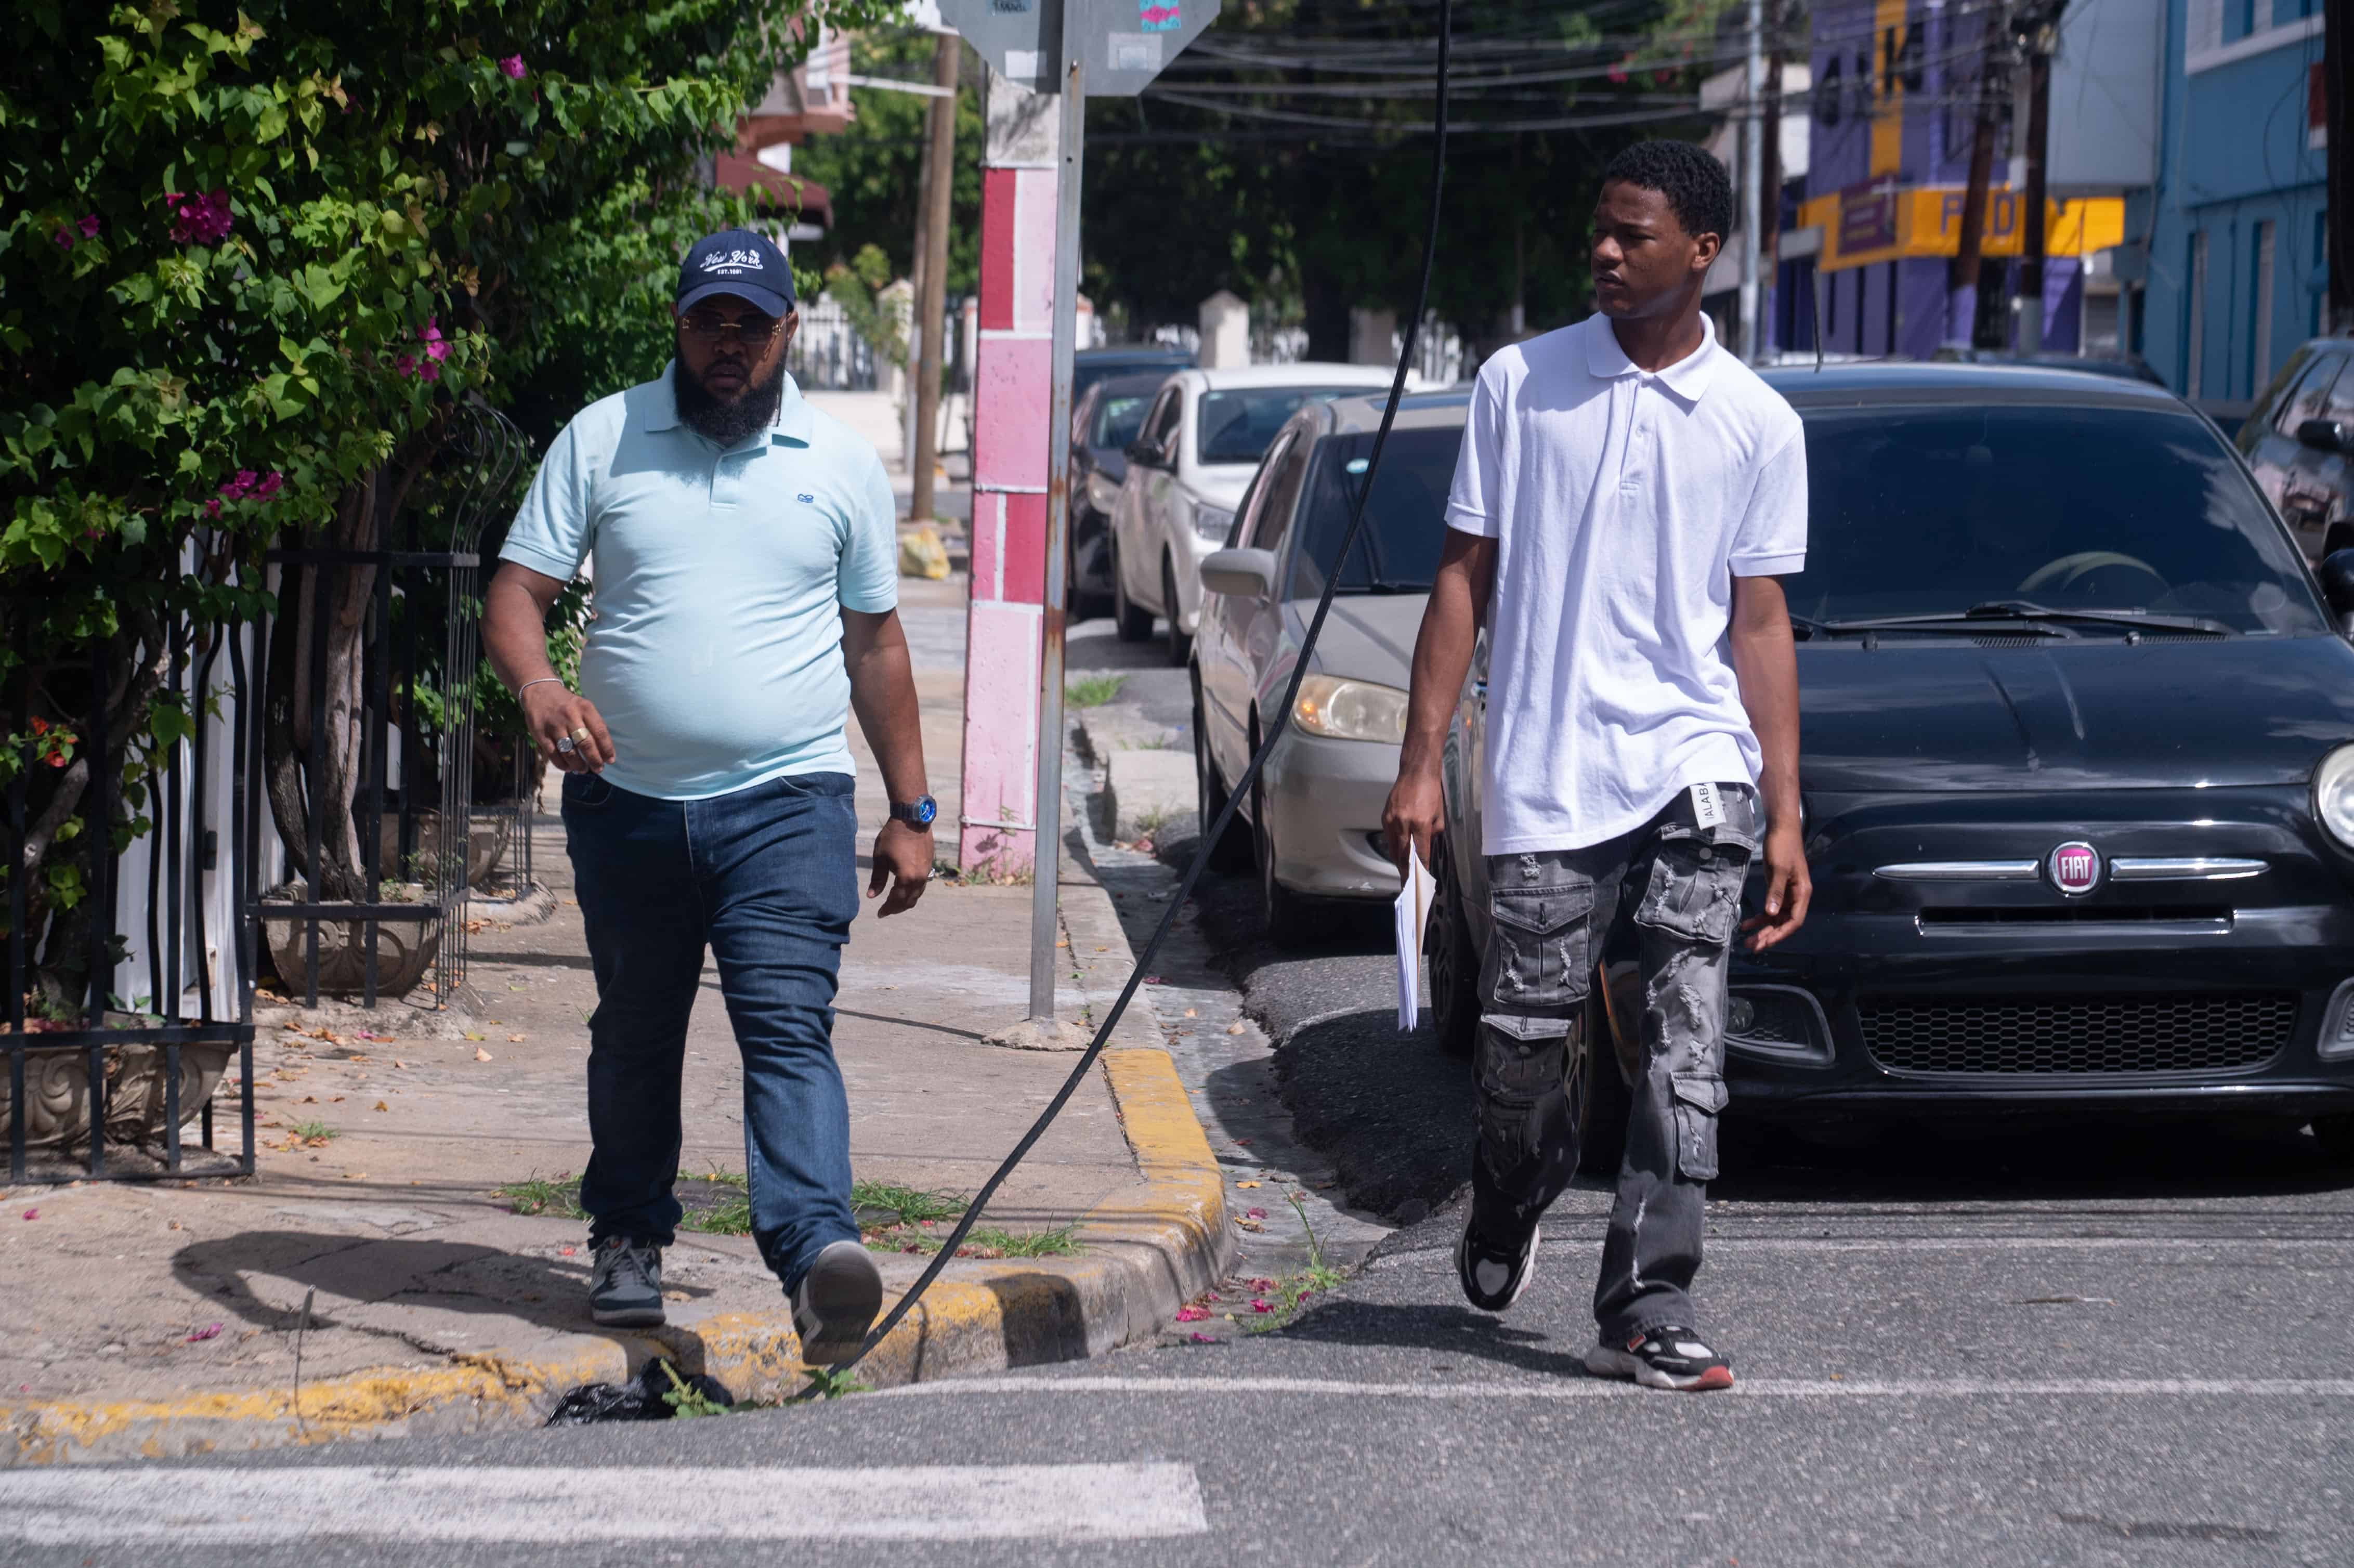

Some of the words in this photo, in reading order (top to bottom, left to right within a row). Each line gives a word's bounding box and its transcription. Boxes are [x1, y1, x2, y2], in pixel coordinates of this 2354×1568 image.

[1940, 194, 2016, 236] PD
[700, 251, 727, 268] New
[729, 250, 760, 267] York
[2061, 856, 2090, 879] FIAT
